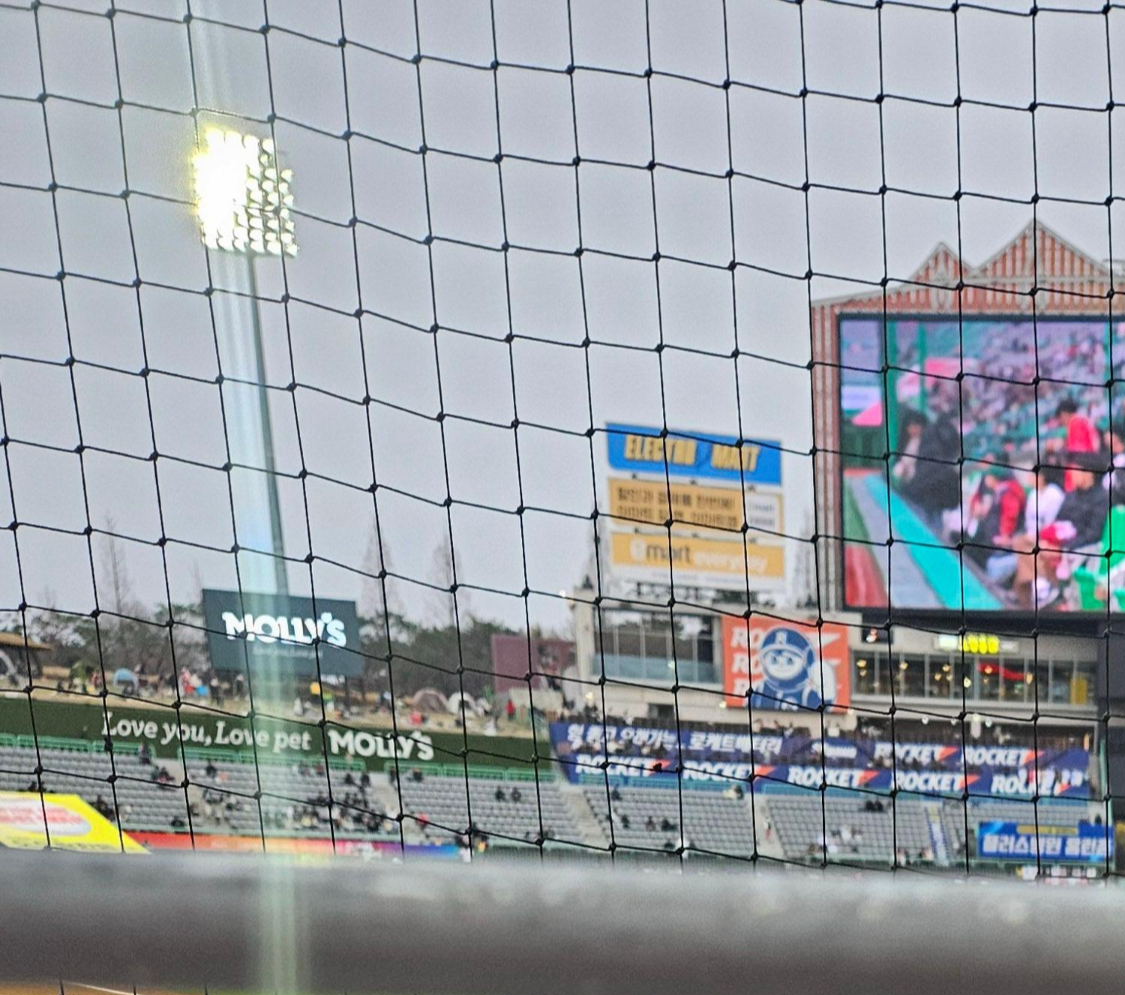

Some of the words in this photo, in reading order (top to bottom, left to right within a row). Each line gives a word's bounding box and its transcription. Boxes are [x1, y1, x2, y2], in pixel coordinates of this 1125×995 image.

[221, 611, 347, 647] MOLLY'S
[101, 712, 157, 738] Love
[161, 720, 212, 746] you,
[214, 721, 269, 746] Love
[273, 730, 312, 752] pet
[328, 729, 434, 761] MOLLY'S
[576, 754, 652, 776] ROCKET
[960, 747, 1028, 766] ROCKET
[683, 760, 753, 782] ROCKET
[789, 766, 860, 787] ROCKET
[891, 770, 962, 791] ROCKET
